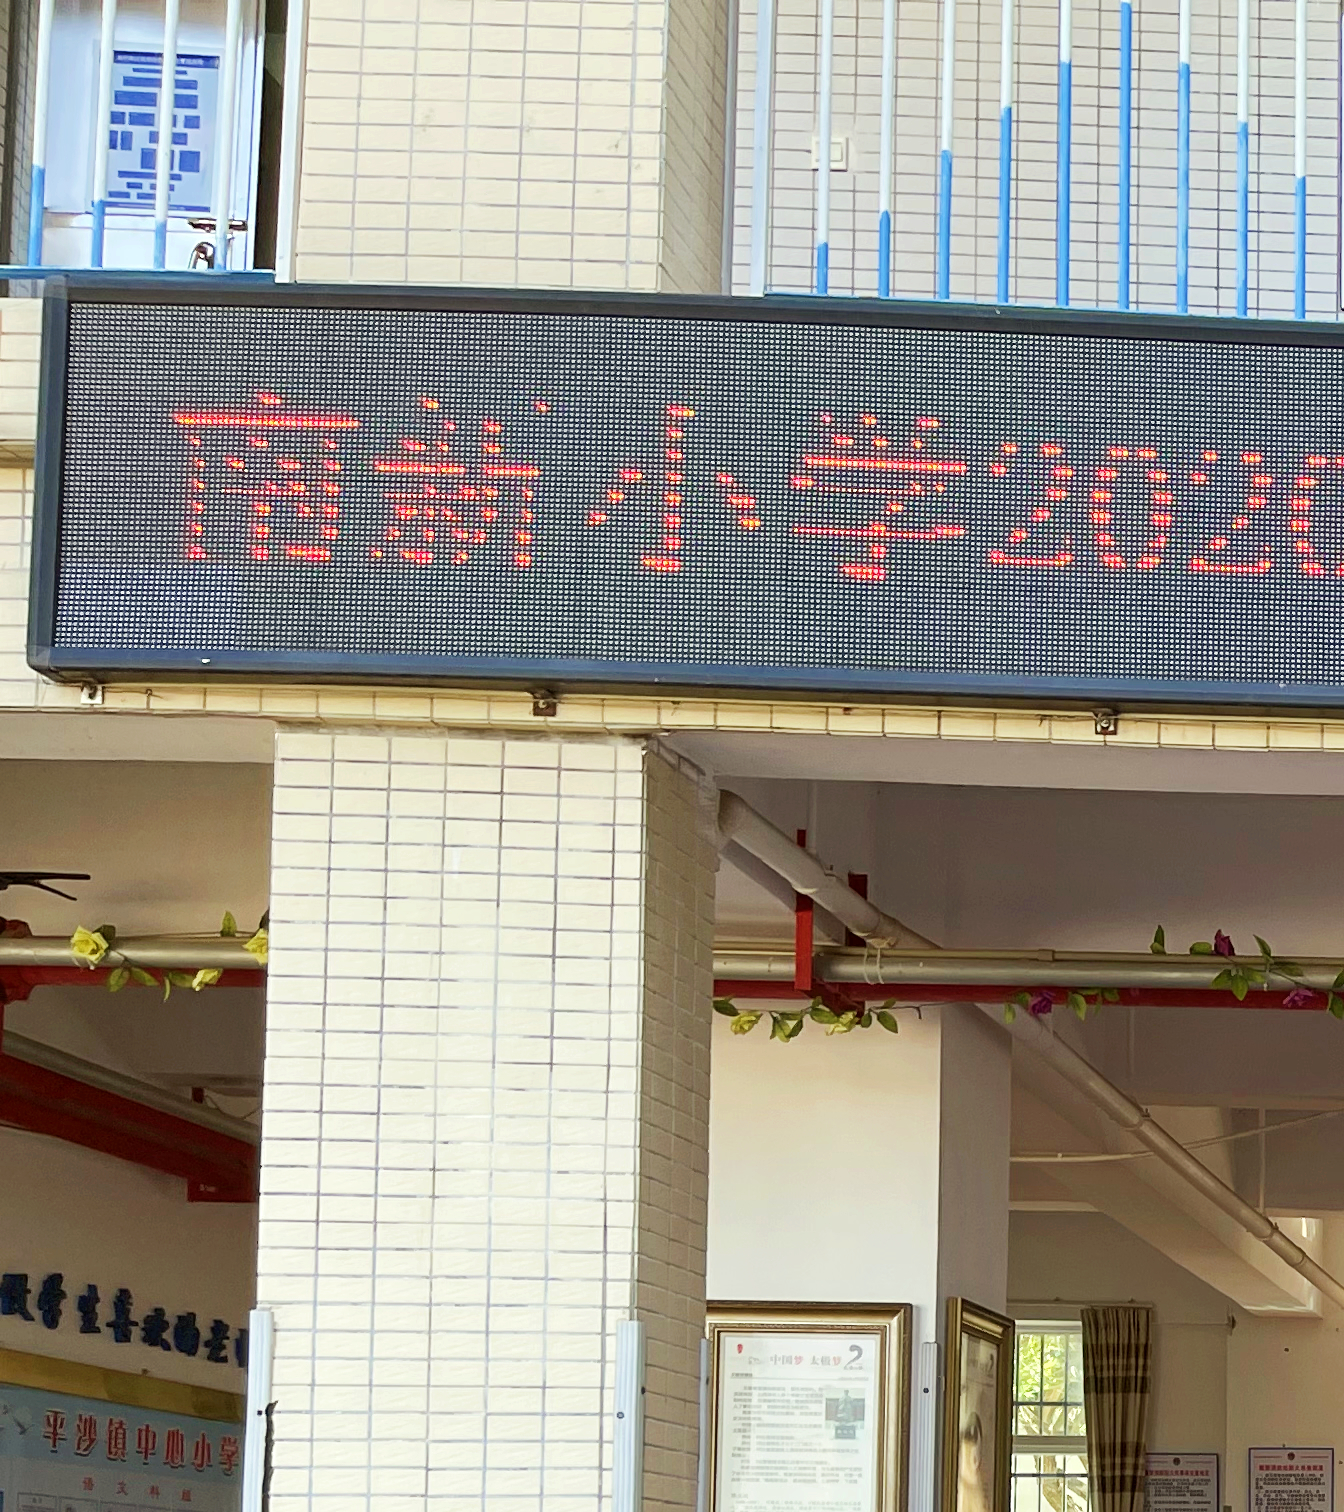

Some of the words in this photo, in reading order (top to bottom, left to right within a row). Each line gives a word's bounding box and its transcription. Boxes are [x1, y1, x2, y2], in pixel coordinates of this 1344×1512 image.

[43, 1409, 240, 1475] 平沙镇中心小学
